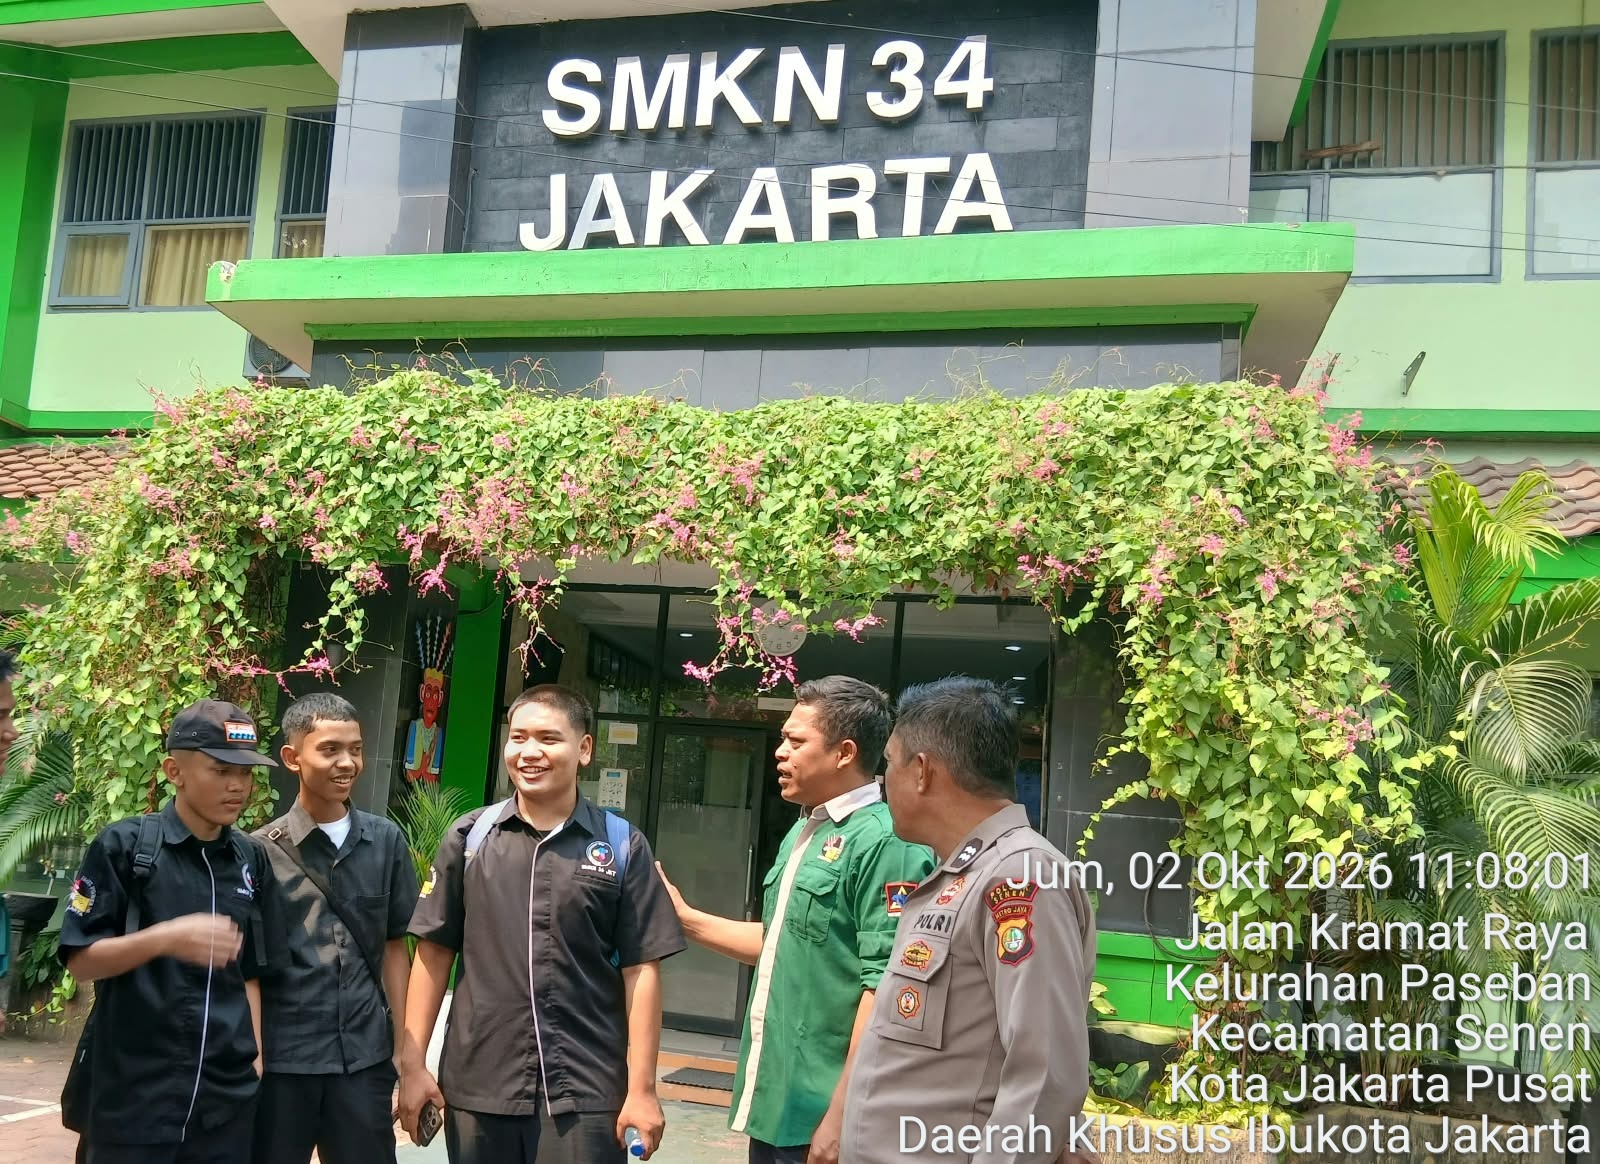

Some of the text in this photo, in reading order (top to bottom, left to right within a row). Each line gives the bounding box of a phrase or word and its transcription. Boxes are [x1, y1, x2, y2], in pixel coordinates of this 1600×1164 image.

[541, 34, 994, 138] SMKN 34
[518, 152, 1015, 252] JAKARTA
[993, 890, 1025, 904] SENEN
[1012, 905, 1028, 914] JAYA
[913, 913, 952, 933] POLRI
